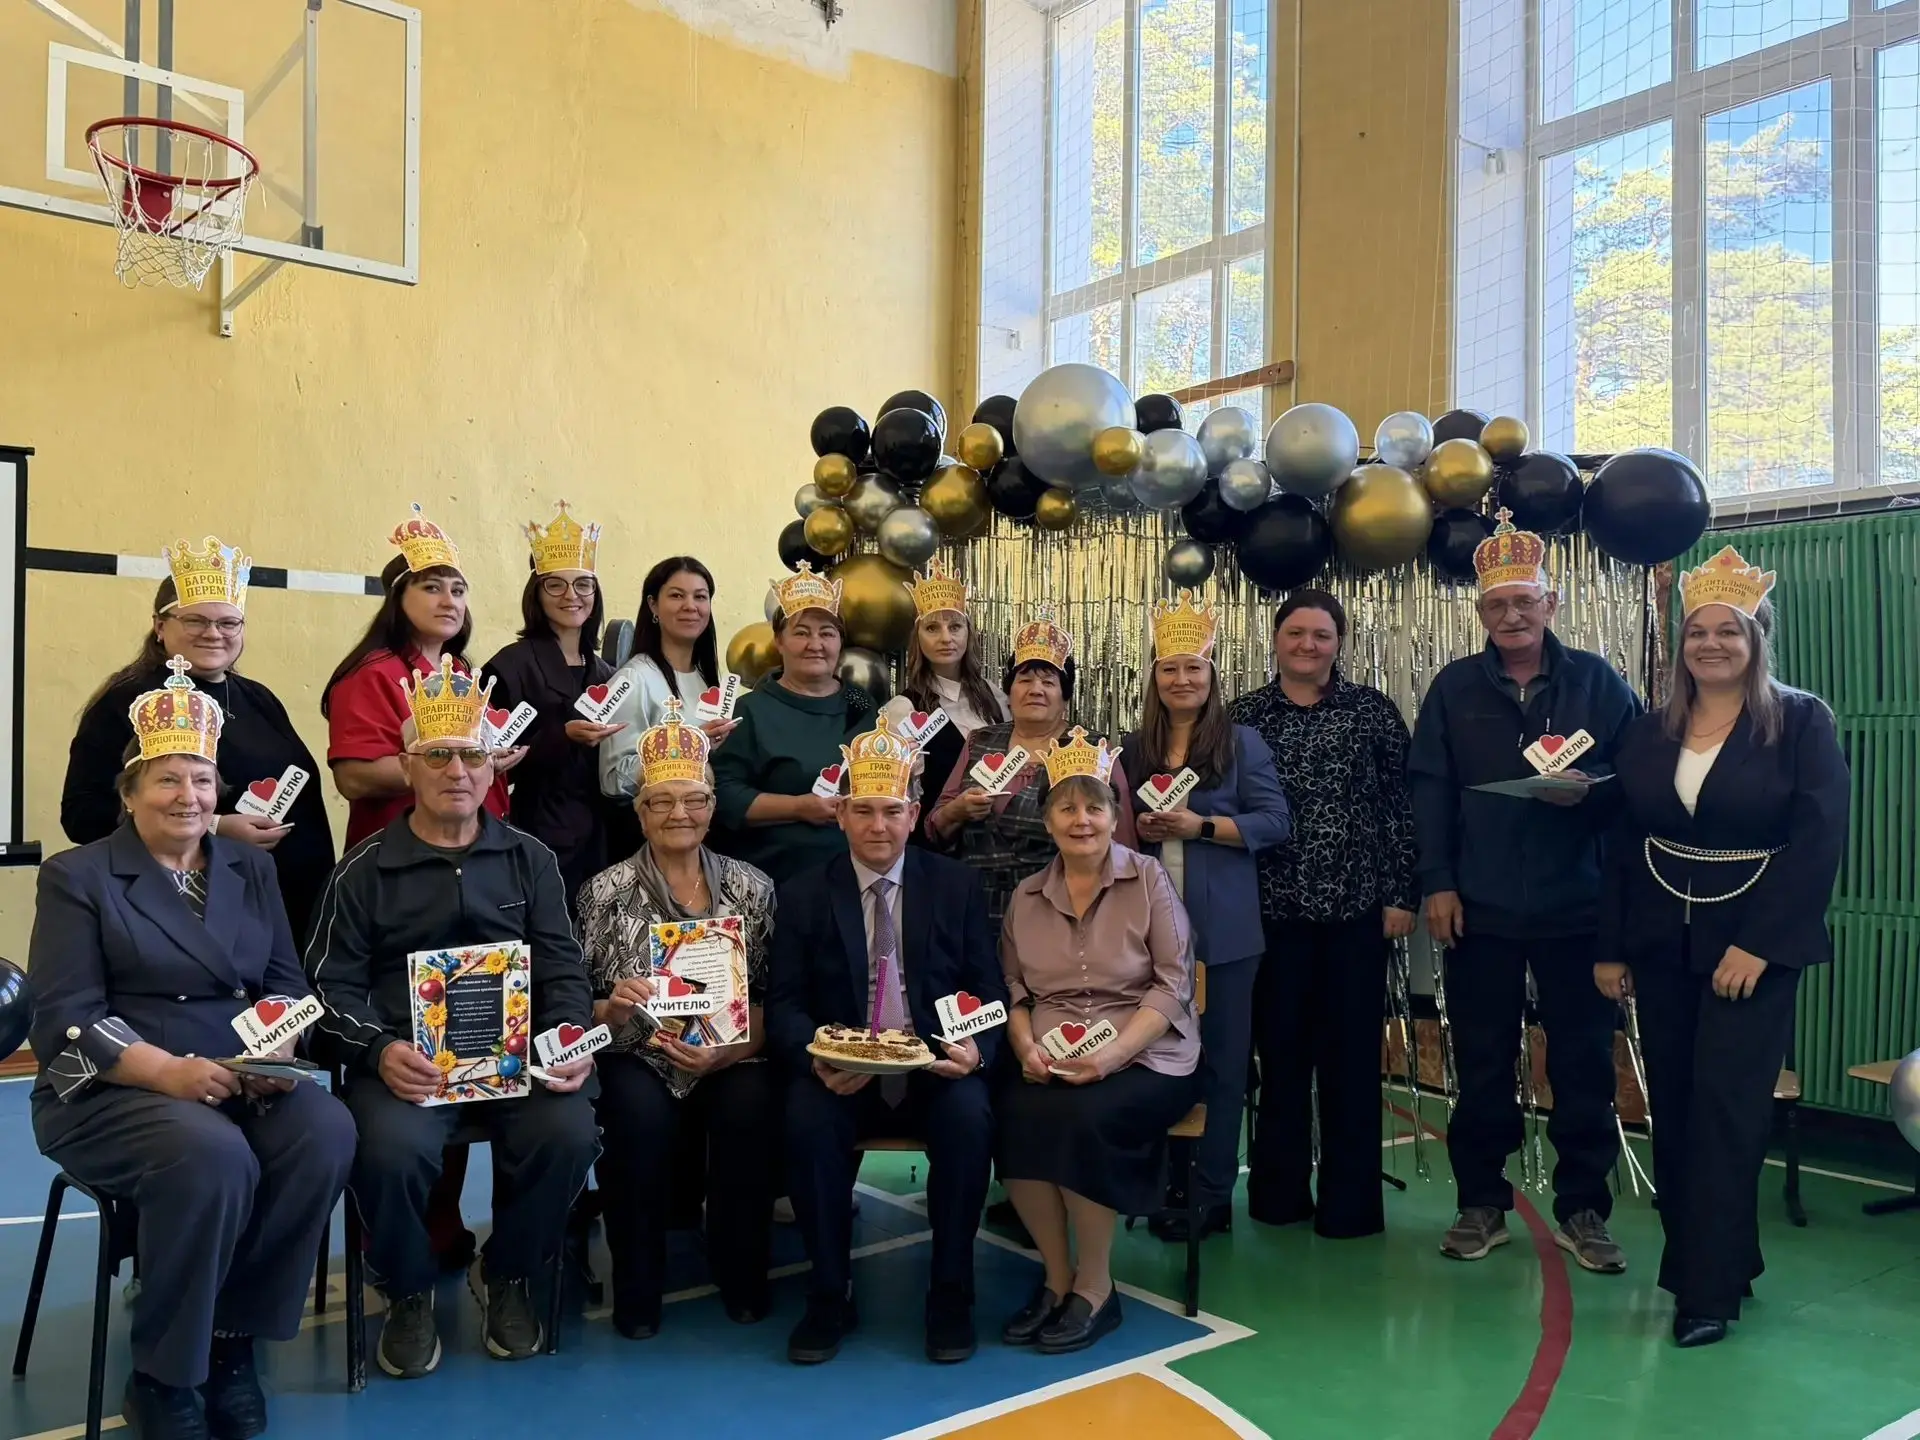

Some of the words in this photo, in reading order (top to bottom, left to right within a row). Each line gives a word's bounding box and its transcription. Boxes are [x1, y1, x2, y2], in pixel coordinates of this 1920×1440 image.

[544, 543, 585, 553] ПРИНЦЕС
[184, 574, 229, 587] БАРОНЕ
[186, 585, 229, 598] ПЕРЕМ
[1167, 622, 1203, 631] ГЛАВНАЯ
[1170, 636, 1200, 645] ШКОЛЫ
[594, 681, 630, 723] УЧИТЕЛЮ
[420, 703, 474, 716] ПРАВИТЕЛЬ
[421, 713, 472, 725] СПОРТЗАЛА
[494, 707, 533, 748] УЧИТЕЛЮ
[914, 713, 946, 745] ЧИТЕЛЮ
[1055, 750, 1099, 764] КОРОЛЕВ
[1541, 735, 1589, 774] УЧИТЕЛЮ
[869, 762, 892, 771] ГРАФ
[988, 750, 1026, 790] УЧИТЕЛЮ
[1056, 757, 1098, 770] ГЛАГОЛО
[852, 771, 904, 781] ТЕРМОДИНАМИ
[1155, 773, 1195, 812] УЧИТЕЛЮ
[651, 1000, 711, 1011] УЧИТЕЛЮ
[252, 1003, 317, 1052] УЧИТЕЛЮ
[948, 1008, 1003, 1036] УЧИТЕЛЮ
[547, 1032, 608, 1067] УЧИТЕЛЮ
